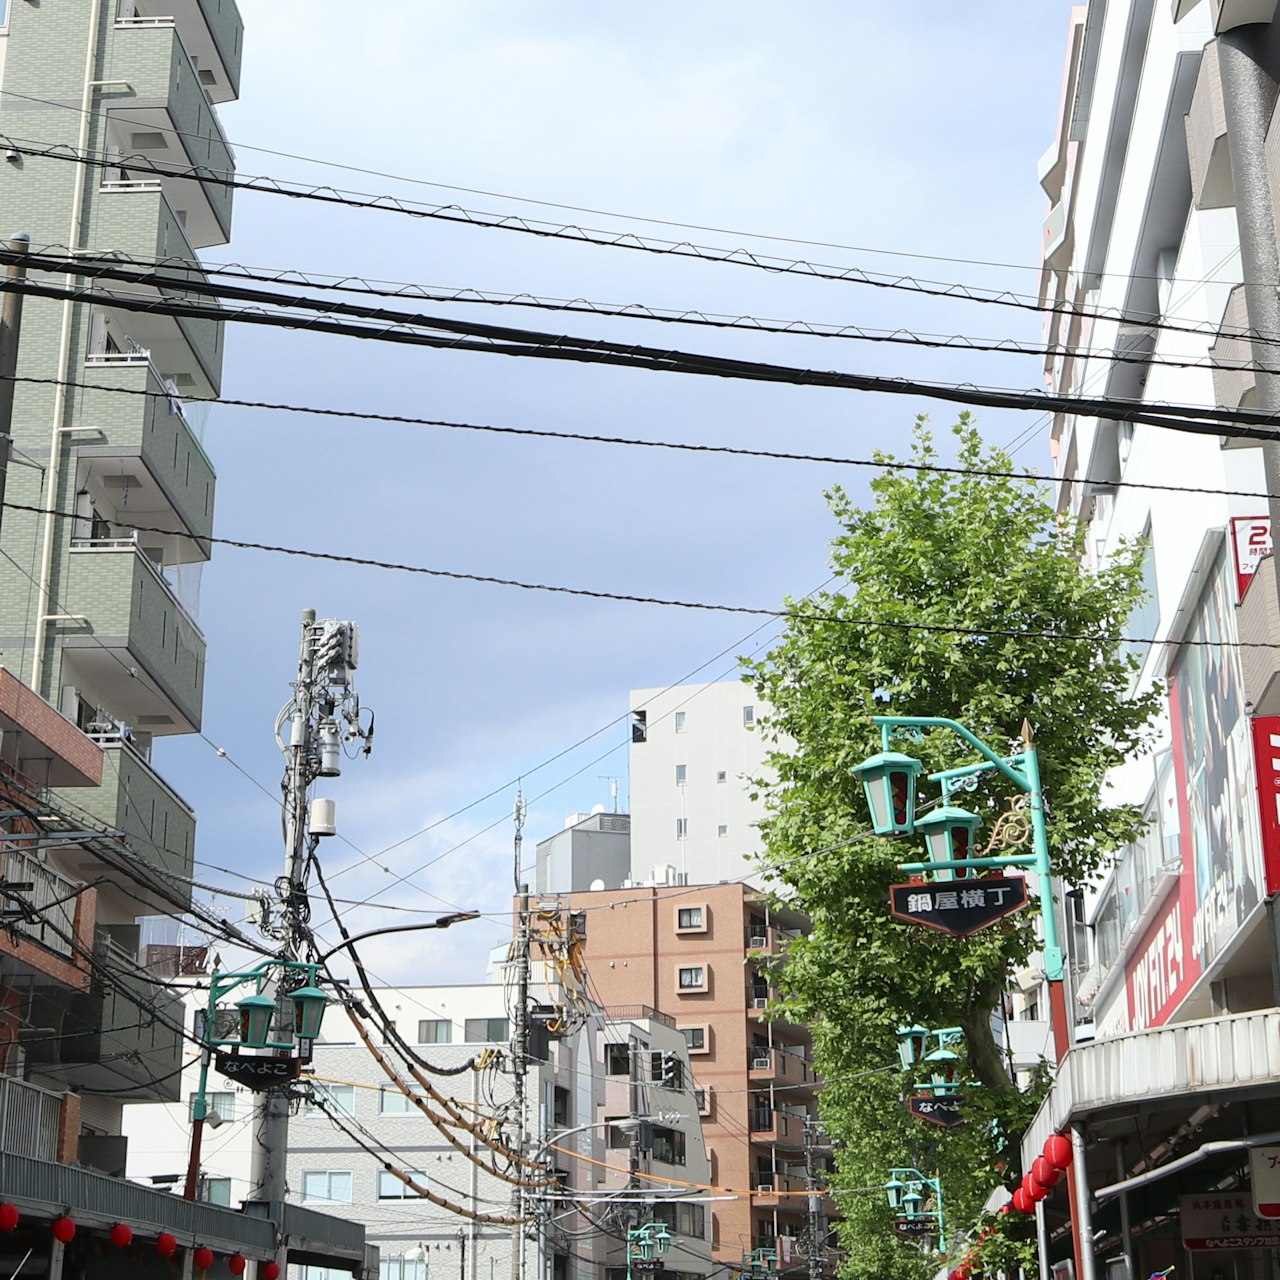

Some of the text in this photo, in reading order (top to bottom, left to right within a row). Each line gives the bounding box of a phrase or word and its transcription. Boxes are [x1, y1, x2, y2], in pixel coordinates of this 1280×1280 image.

[1248, 525, 1271, 546] 2
[906, 886, 1011, 913] 鍋屋横丁
[223, 1060, 288, 1075] なべよこ
[918, 1100, 961, 1113] なべよ
